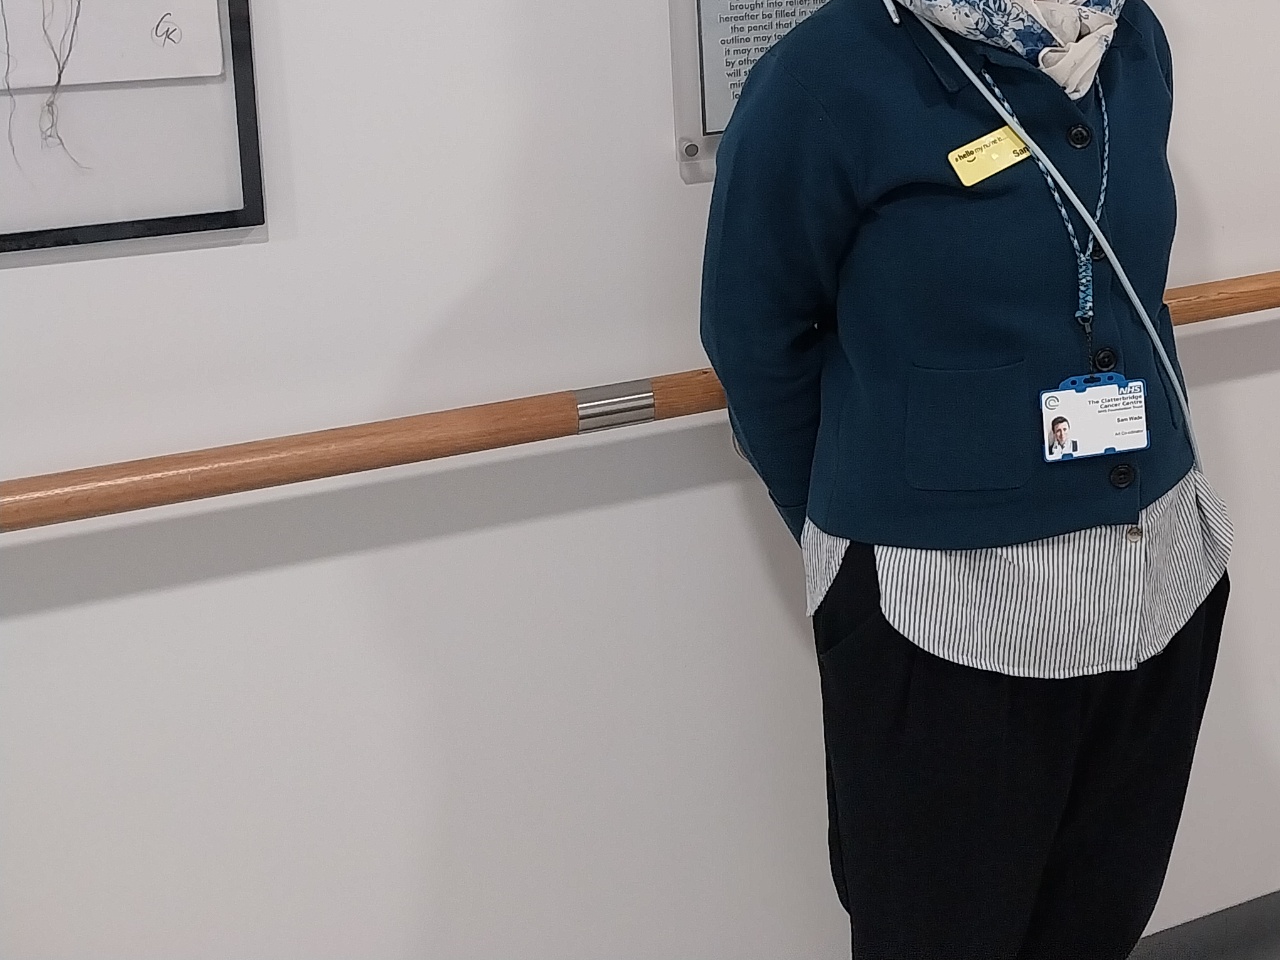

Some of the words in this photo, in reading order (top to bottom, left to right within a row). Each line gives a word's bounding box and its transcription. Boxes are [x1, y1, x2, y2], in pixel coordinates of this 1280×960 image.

[729, 0, 764, 11] brought
[718, 12, 760, 24] hereafter
[761, 11, 773, 20] be
[775, 8, 796, 19] filled
[798, 8, 807, 17] in
[730, 24, 745, 34] the
[747, 21, 773, 34] pencil
[775, 20, 792, 30] that
[720, 35, 751, 45] outline
[753, 34, 772, 44] may
[724, 47, 731, 57] it
[732, 47, 752, 57] may
[725, 58, 736, 69] by
[725, 68, 742, 78] will
[1119, 385, 1142, 395] NHS
[1101, 395, 1142, 404] Clatterbridge
